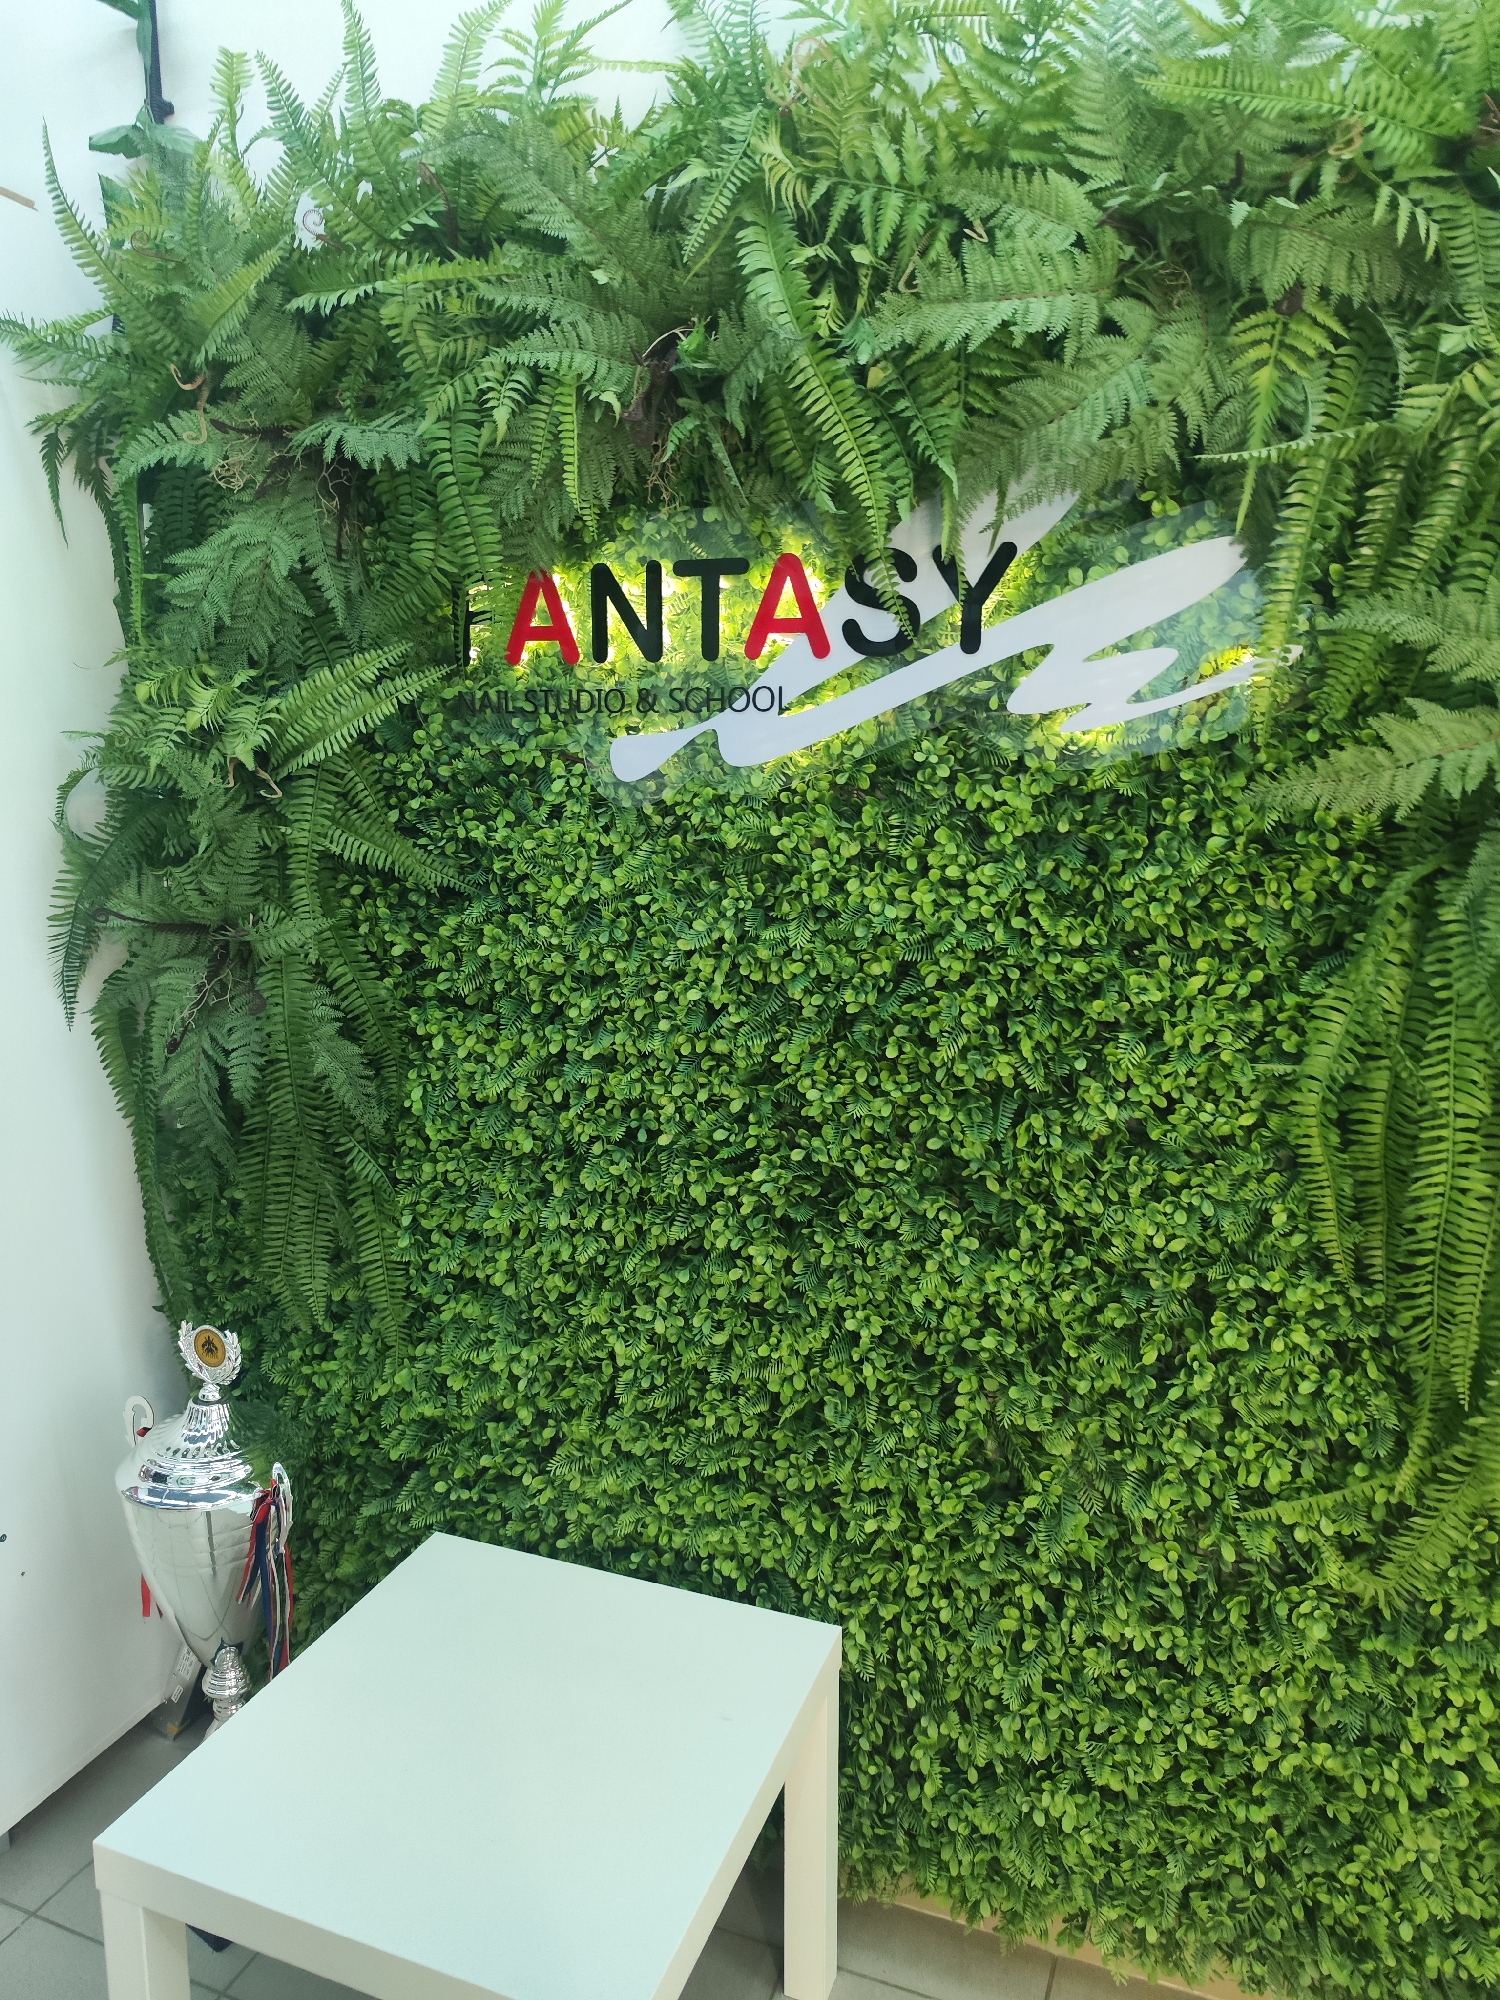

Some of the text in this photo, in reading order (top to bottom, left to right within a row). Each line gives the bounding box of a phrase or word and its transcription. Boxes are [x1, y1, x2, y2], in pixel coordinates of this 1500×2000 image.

[457, 685, 791, 714] NAIL STUDIO & SCHOOL
